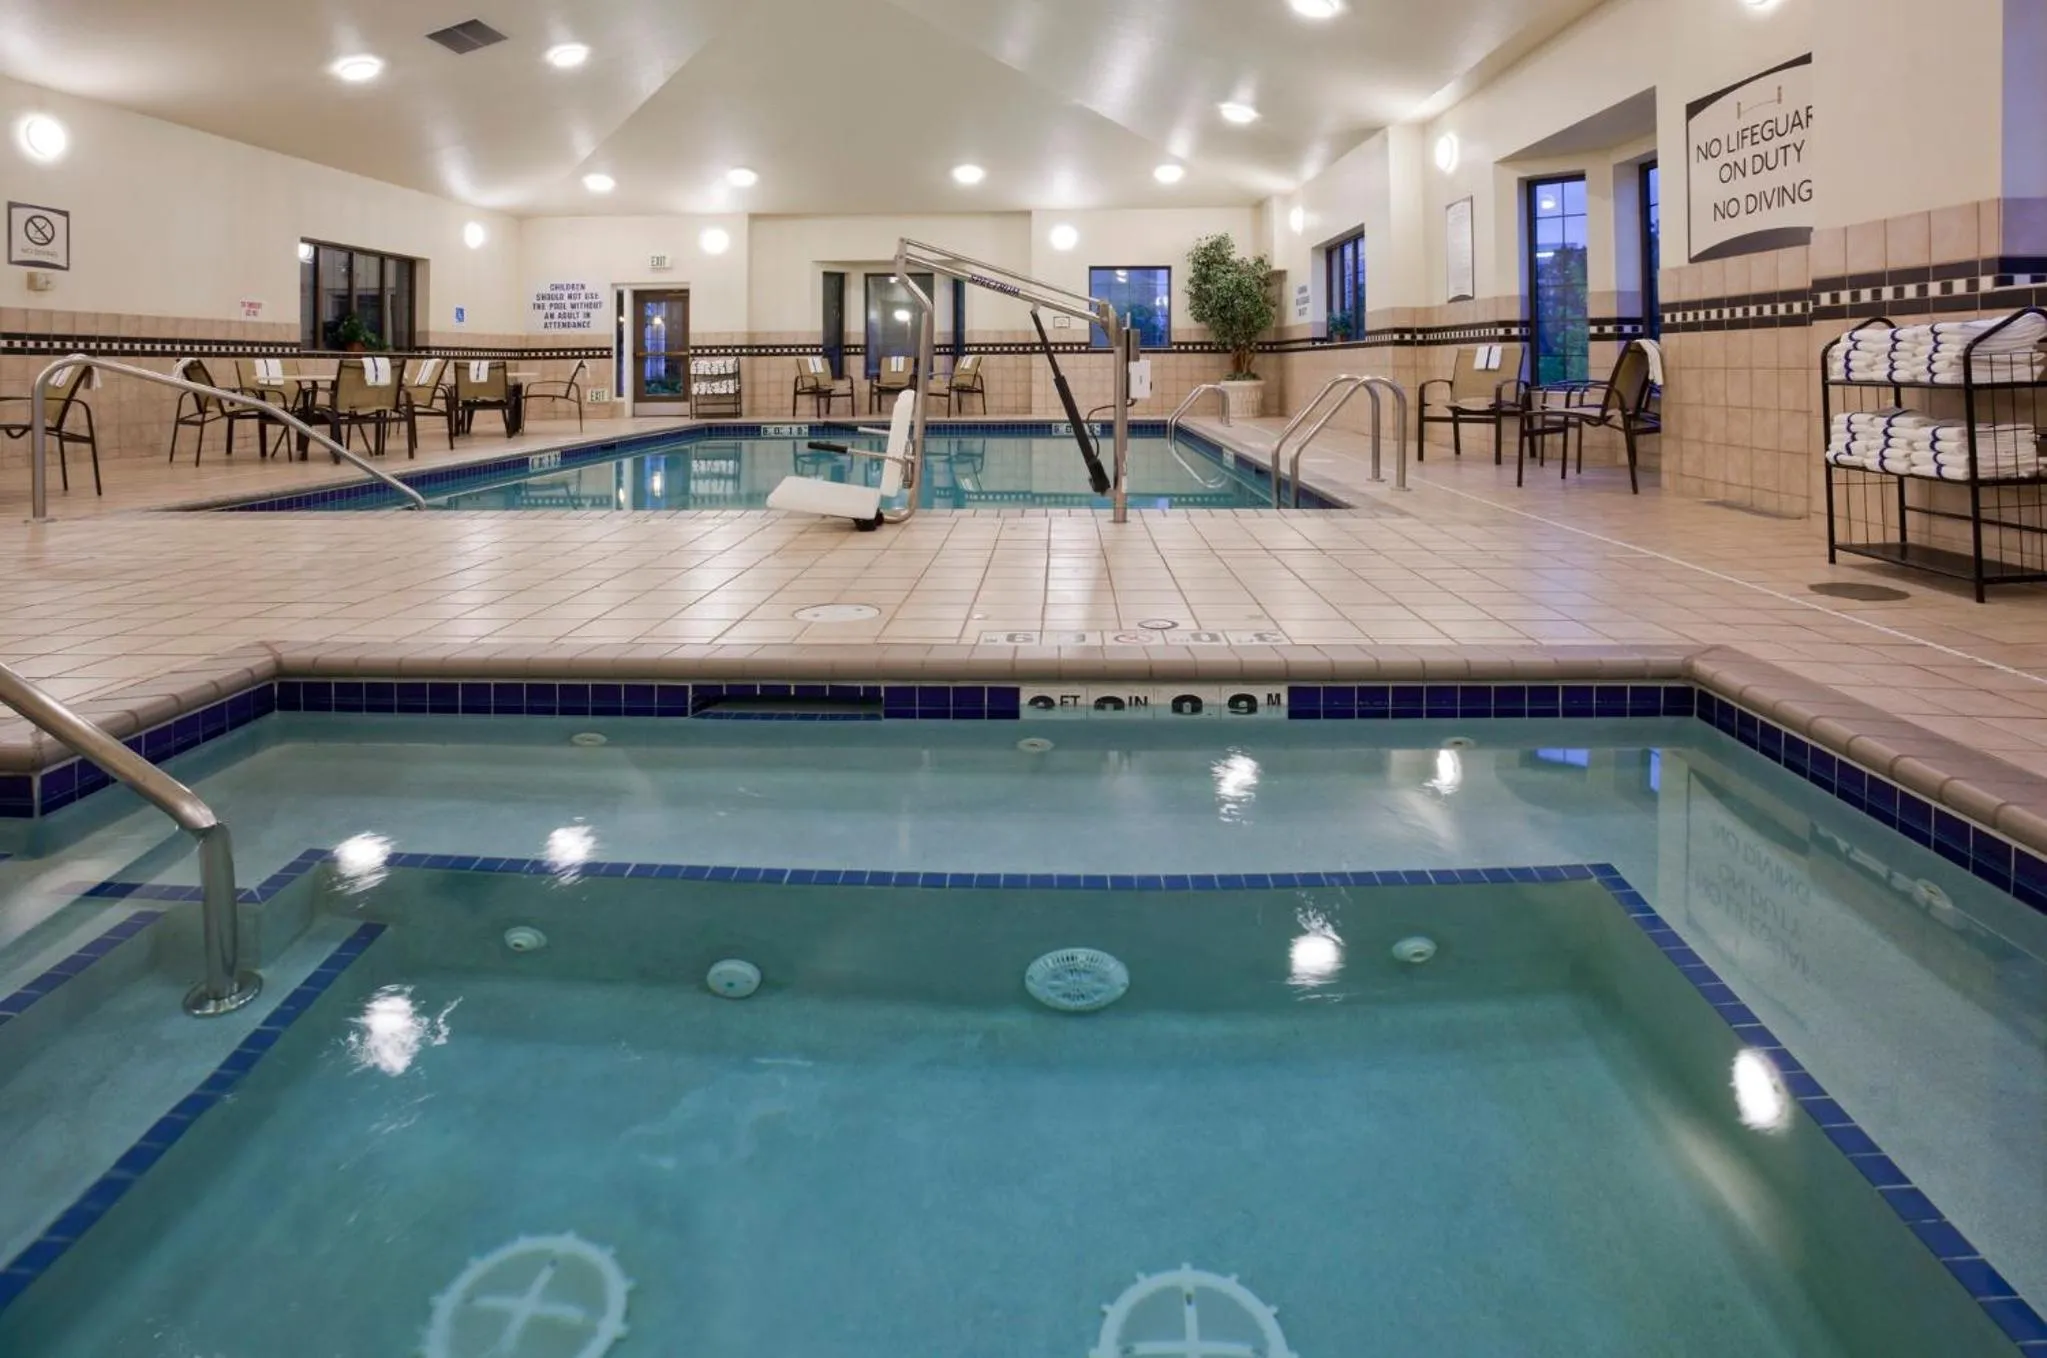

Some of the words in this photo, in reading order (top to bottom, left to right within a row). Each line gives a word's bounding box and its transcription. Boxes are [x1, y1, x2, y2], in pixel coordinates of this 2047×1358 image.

[1696, 137, 1722, 163] NO
[1719, 158, 1747, 184] ON
[1752, 139, 1806, 176] DUTY
[1713, 197, 1741, 222] NO
[1746, 179, 1813, 215] DIVING
[651, 255, 667, 267] EXIT
[549, 283, 586, 291] CHILDREN
[536, 293, 565, 301] SHOULD
[585, 292, 599, 300] USE
[549, 302, 567, 310] POOL
[570, 301, 603, 310] WITHOUT
[544, 312, 555, 320] AN
[558, 312, 580, 320] ADULT
[543, 321, 591, 329] ATTENDANCE
[590, 390, 606, 402] EXIT
